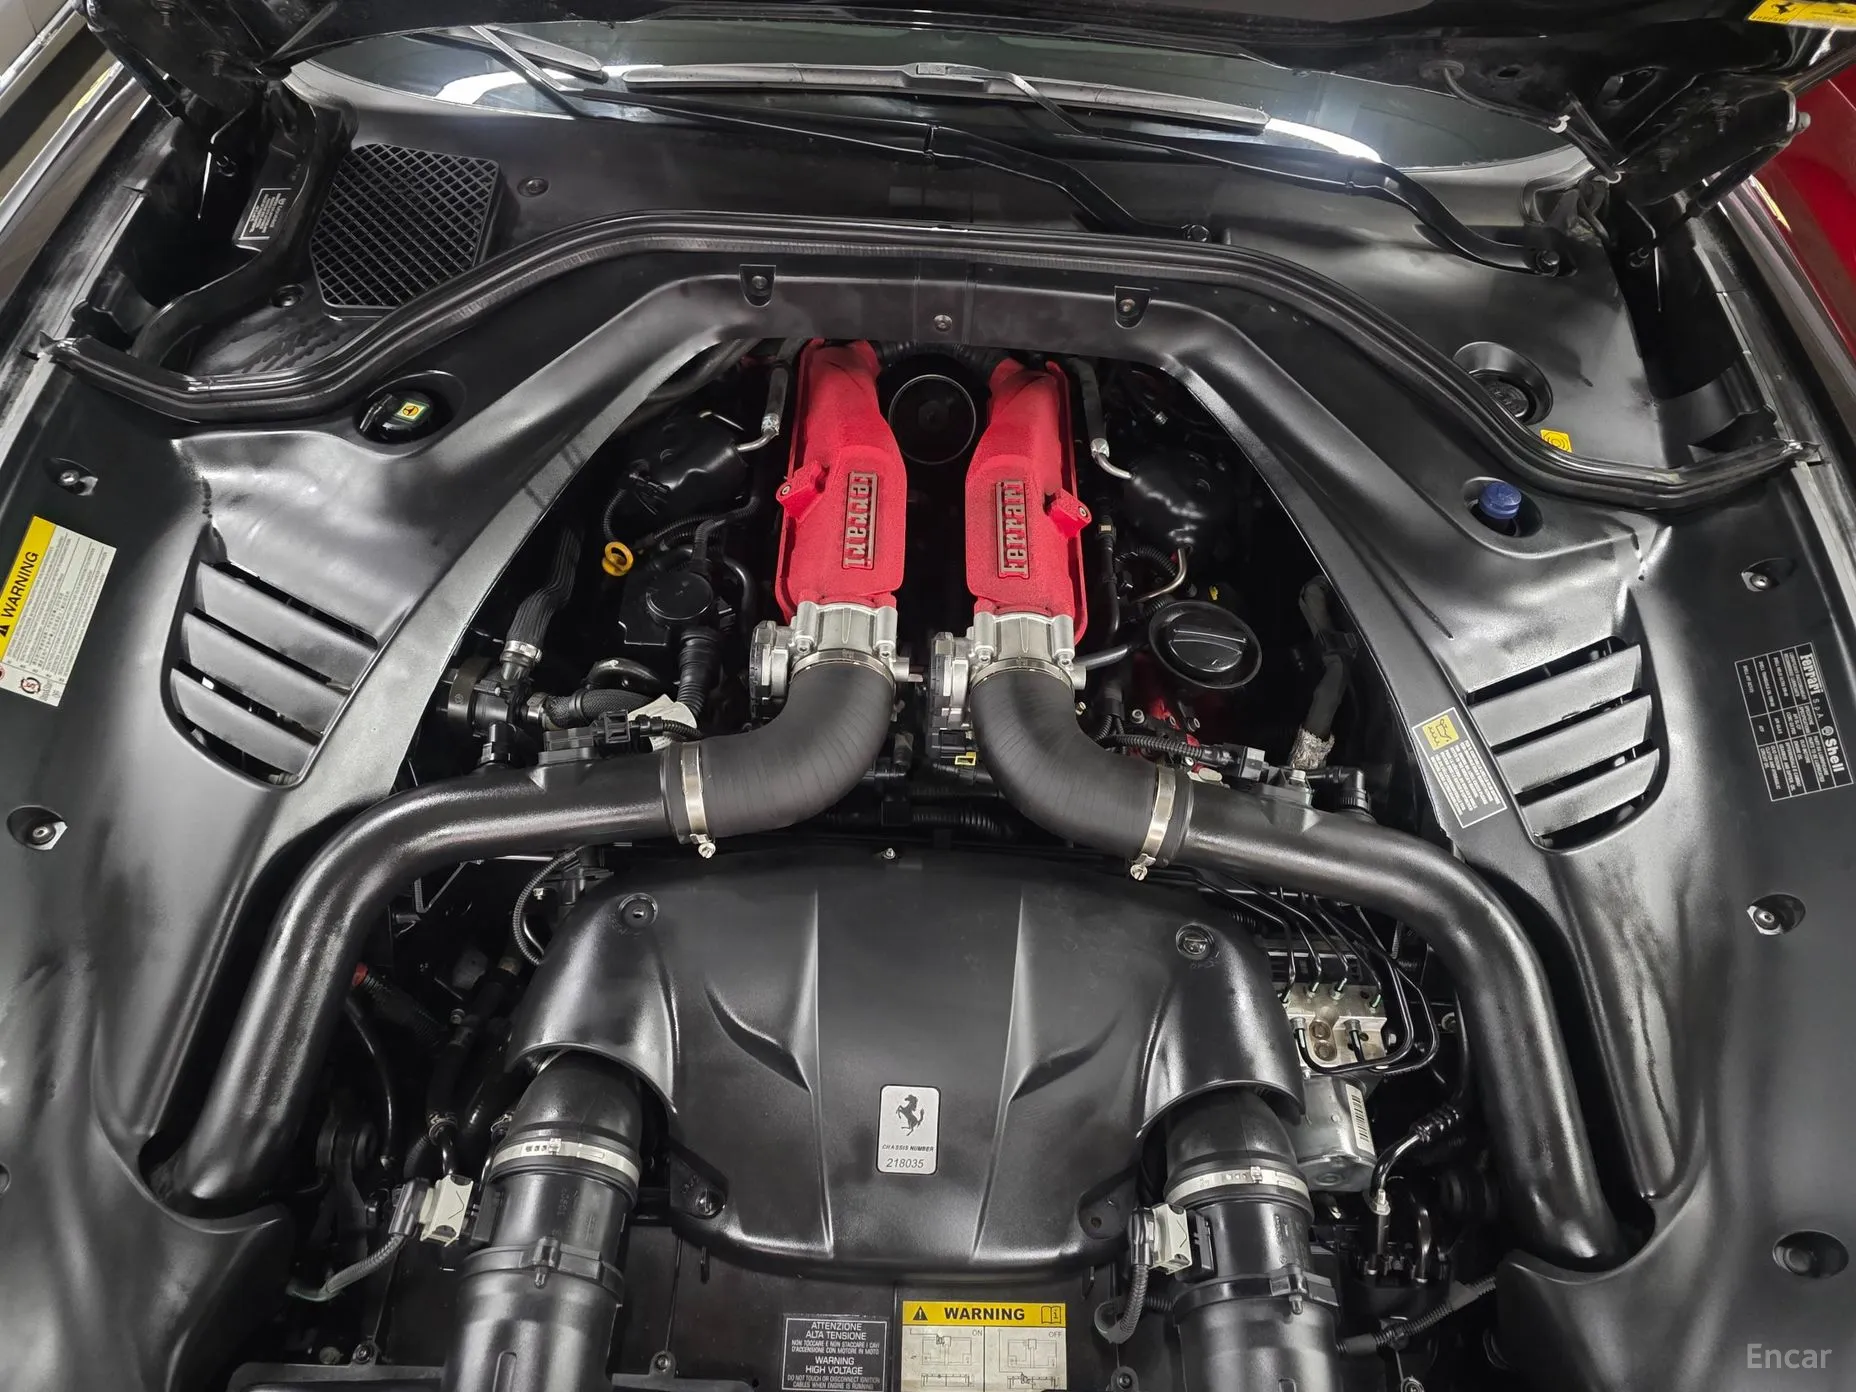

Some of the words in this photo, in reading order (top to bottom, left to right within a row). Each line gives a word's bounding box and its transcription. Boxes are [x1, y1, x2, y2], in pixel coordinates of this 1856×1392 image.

[846, 472, 877, 569] Ferrari
[997, 480, 1029, 578] Ferrari
[1, 551, 39, 617] WARNING
[1800, 653, 1823, 695] Ferrari
[1825, 738, 1845, 773] Shell
[886, 1158, 925, 1168] 218035
[944, 1307, 1025, 1321] WARNING
[811, 1321, 863, 1331] ATTENZIONE
[805, 1330, 824, 1339] ALTA
[826, 1331, 867, 1340] TENSIONE
[815, 1356, 855, 1365] WARNING
[805, 1365, 826, 1374] HIGH
[828, 1366, 863, 1375] VOLTAGE
